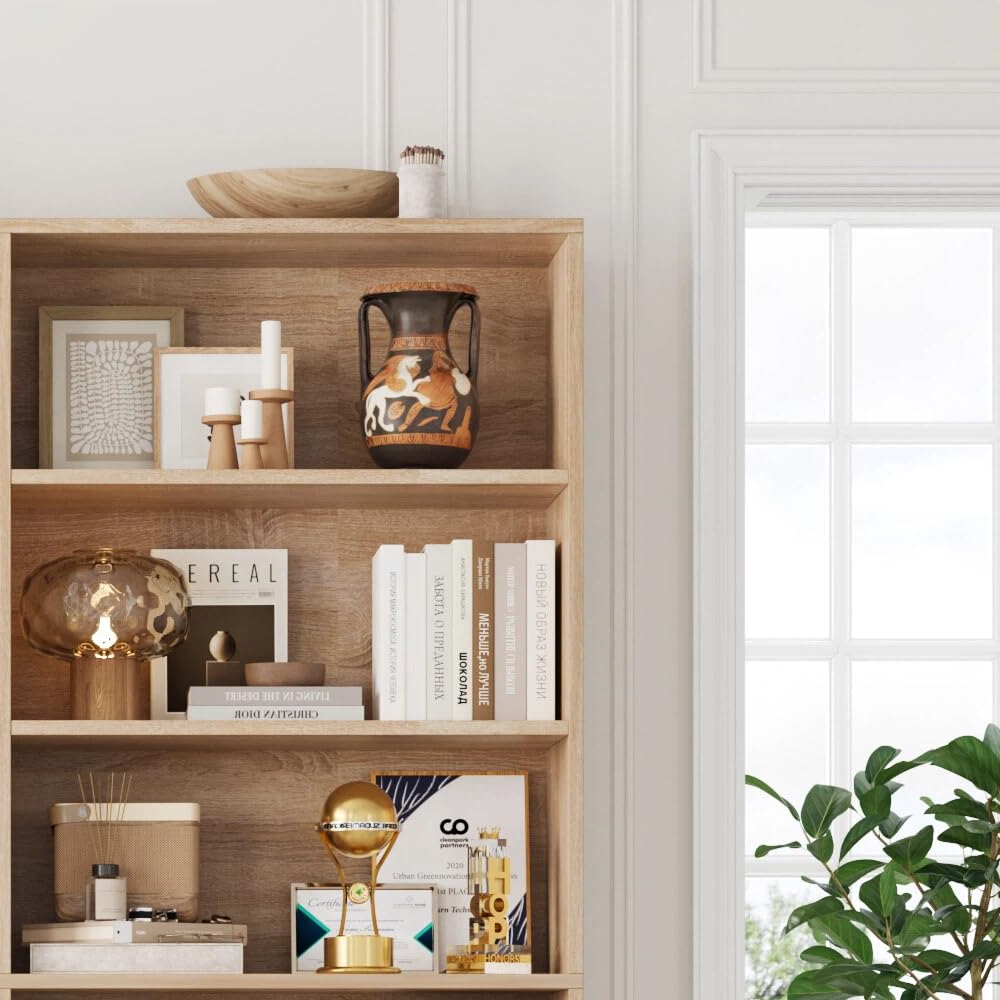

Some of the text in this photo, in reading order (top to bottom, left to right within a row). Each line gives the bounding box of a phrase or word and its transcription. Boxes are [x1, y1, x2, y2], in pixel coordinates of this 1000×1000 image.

[188, 563, 277, 583] EREAL
[433, 576, 444, 700] ЗАБОТА О ПРЕДАННЫХ
[536, 564, 548, 700] НОВЫЙ ОБРАЗ ЖИЗНИ
[458, 652, 467, 705] ШОКОЛАД
[478, 672, 489, 706] ЛУЧШЕ
[392, 872, 415, 880] Urban
